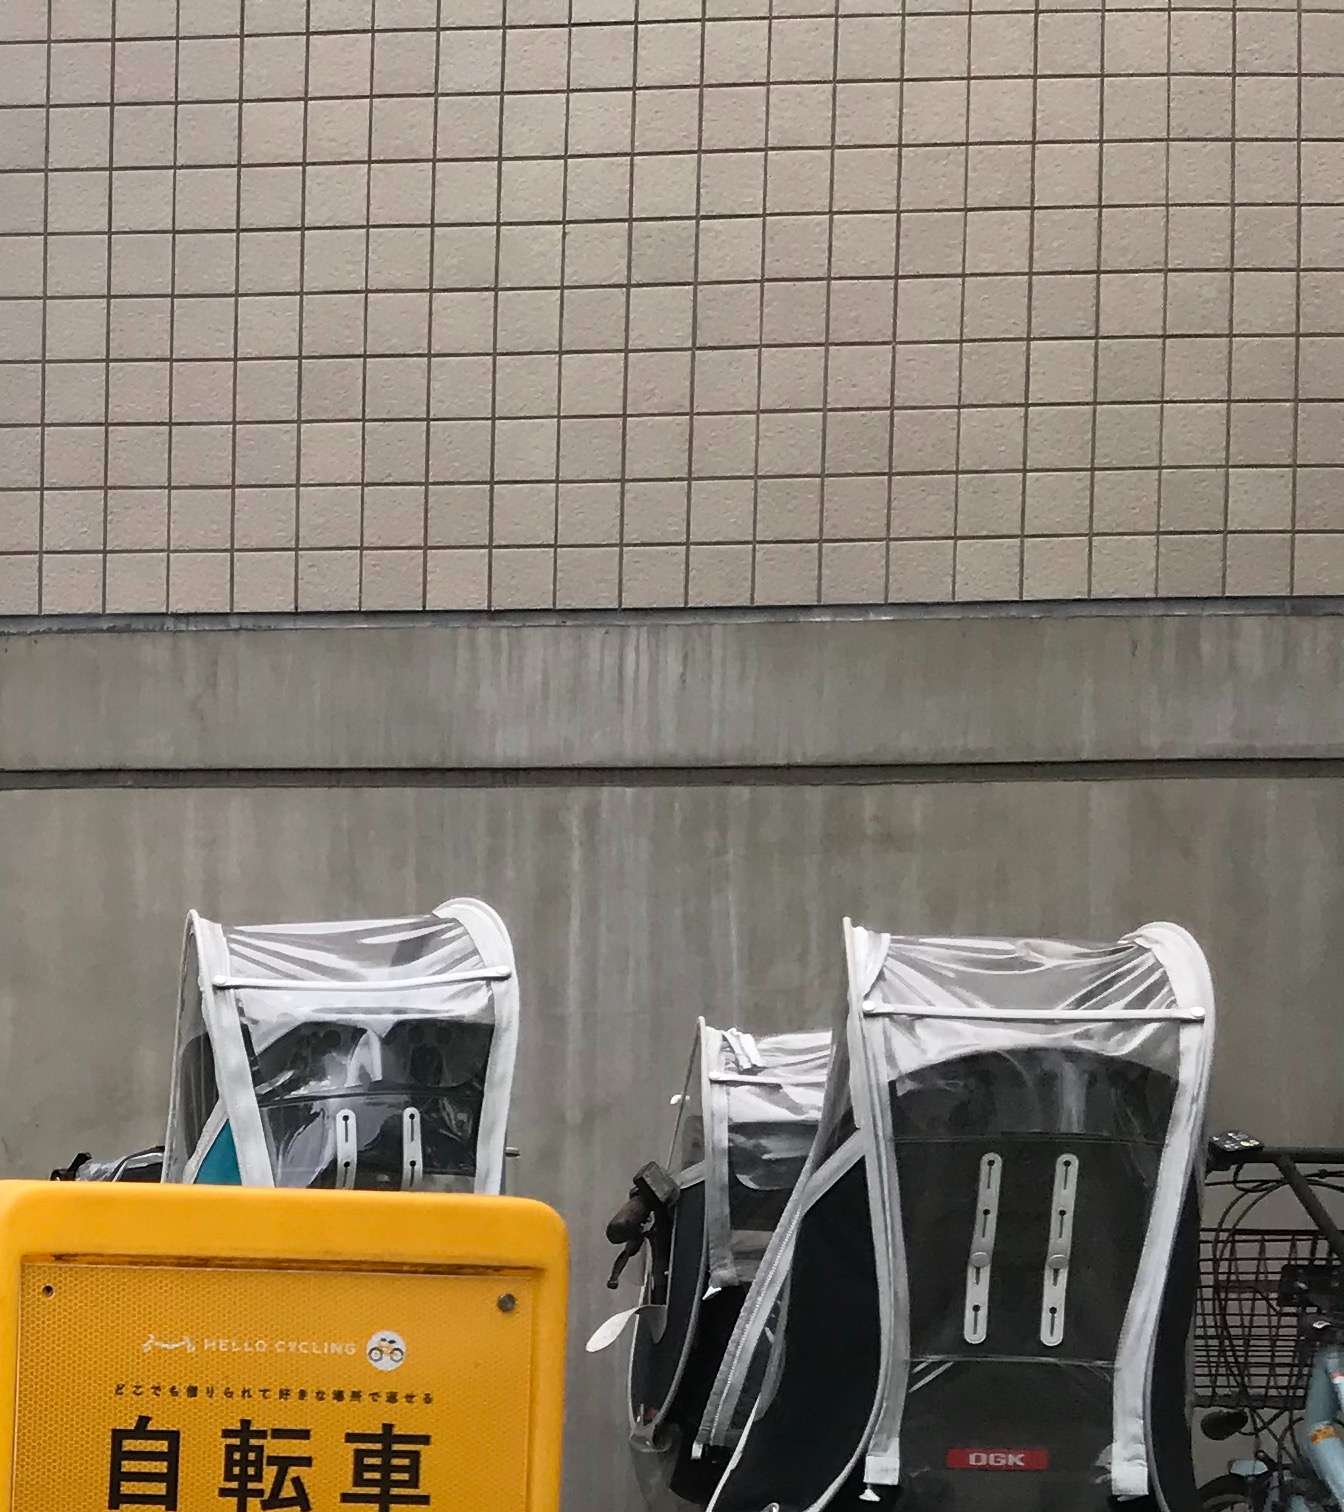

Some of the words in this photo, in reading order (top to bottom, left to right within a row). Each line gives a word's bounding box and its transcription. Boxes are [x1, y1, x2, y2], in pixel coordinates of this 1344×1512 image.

[203, 1338, 268, 1352] HELLO
[274, 1339, 357, 1356] CYCLING
[114, 1383, 433, 1405] どこでも借りられて好きな場所で返せる
[968, 1452, 1025, 1466] OGK
